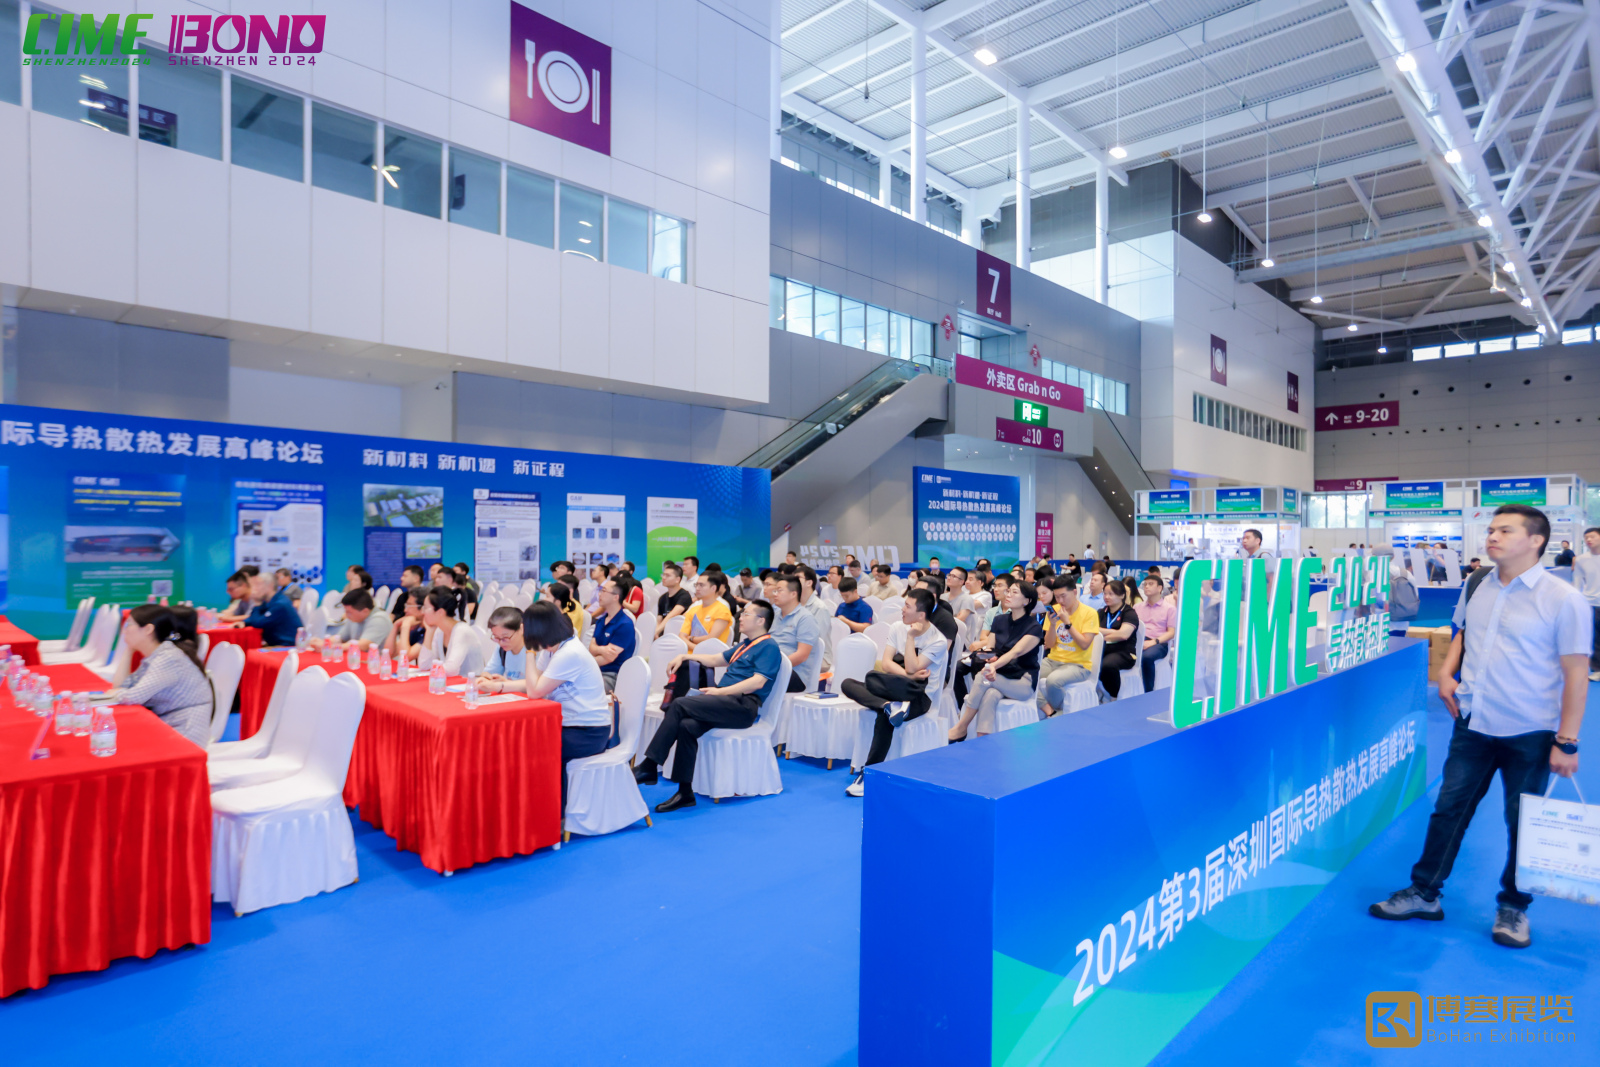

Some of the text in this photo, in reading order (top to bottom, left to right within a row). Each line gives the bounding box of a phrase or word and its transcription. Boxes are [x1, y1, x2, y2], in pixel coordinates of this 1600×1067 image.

[987, 267, 1000, 304] 7
[986, 367, 1061, 400] 外卖区 Grab n Go
[1031, 428, 1042, 445] 10
[1355, 407, 1390, 424] 9-20
[1, 419, 565, 478] 际导热散热发展高峰论坛 新材料 新机遇 新征程
[1356, 480, 1363, 490] 9
[1327, 555, 1391, 612] 2024
[1170, 558, 1322, 729] CIME
[1325, 611, 1391, 674] 导热散热展
[1072, 720, 1416, 1007] 2024第3届深圳国际导热散热发展高峰论坛
